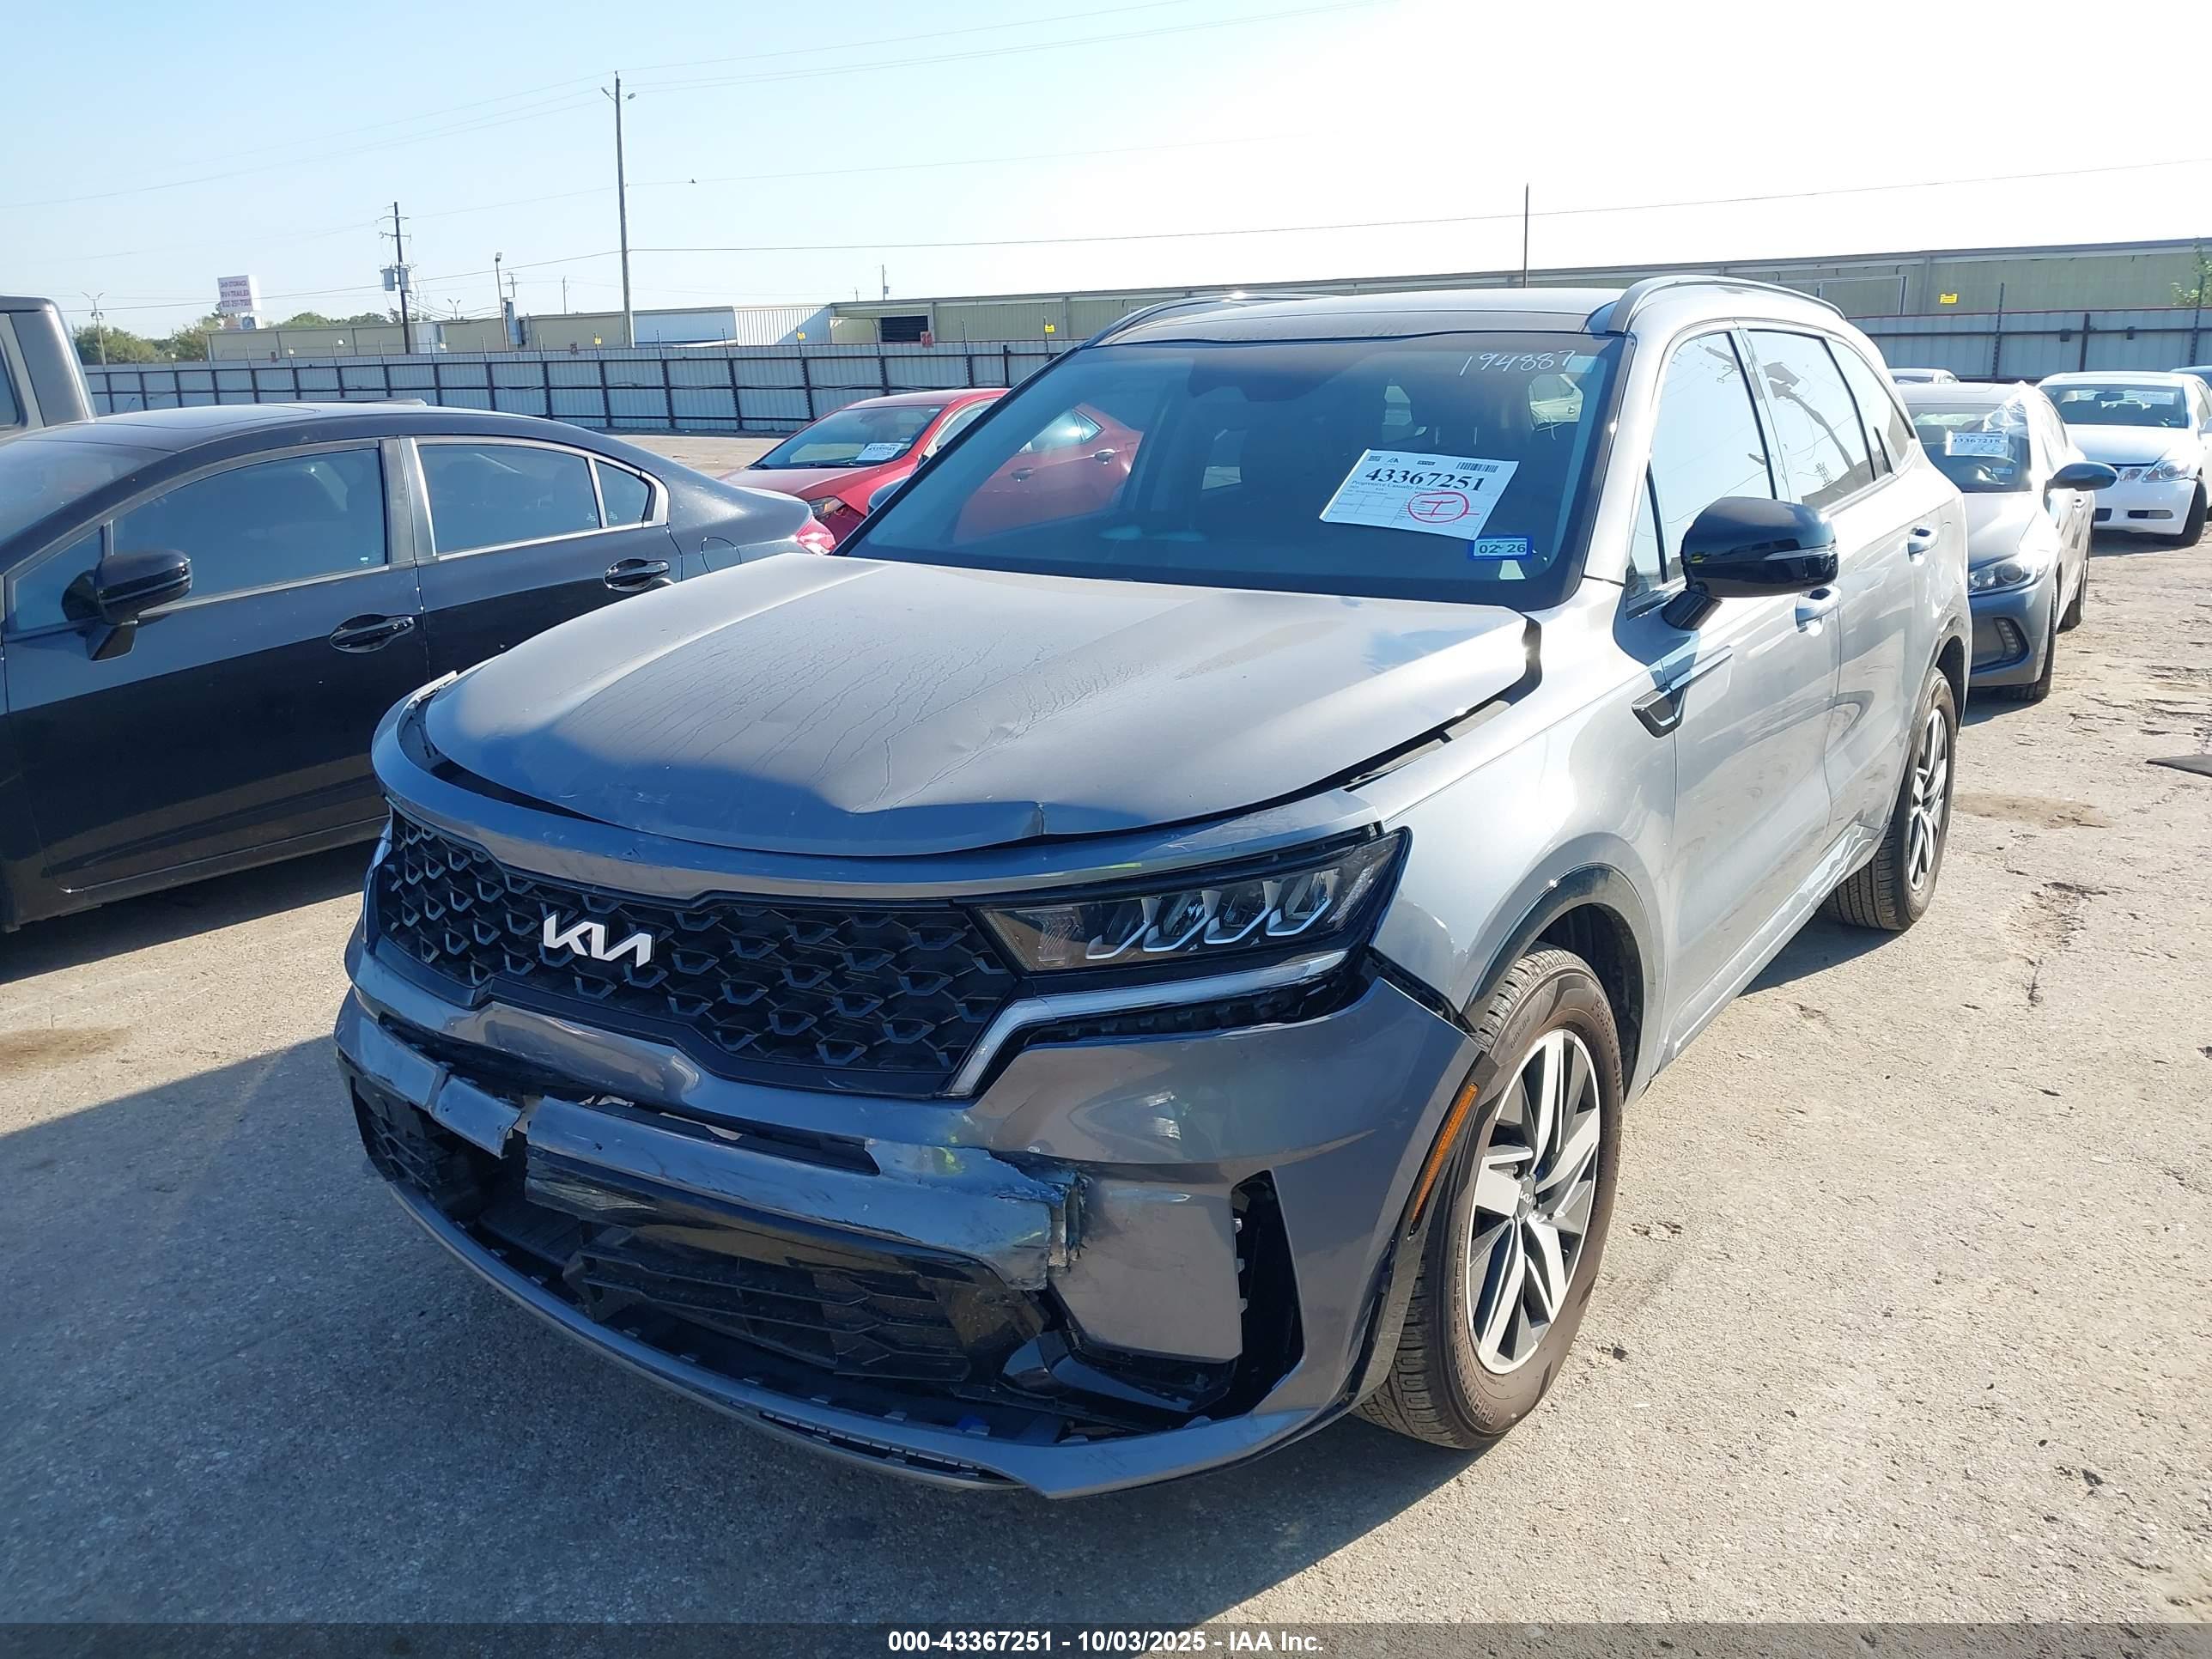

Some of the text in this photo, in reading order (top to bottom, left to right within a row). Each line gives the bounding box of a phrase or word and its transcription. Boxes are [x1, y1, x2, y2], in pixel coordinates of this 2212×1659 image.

[1460, 349, 1576, 377] 194887
[1352, 480, 1386, 489] Progressive
[1387, 482, 1413, 490] Casualty
[1364, 467, 1485, 491] 43367251
[1479, 544, 1526, 554] 02 26
[544, 914, 653, 968] KIA
